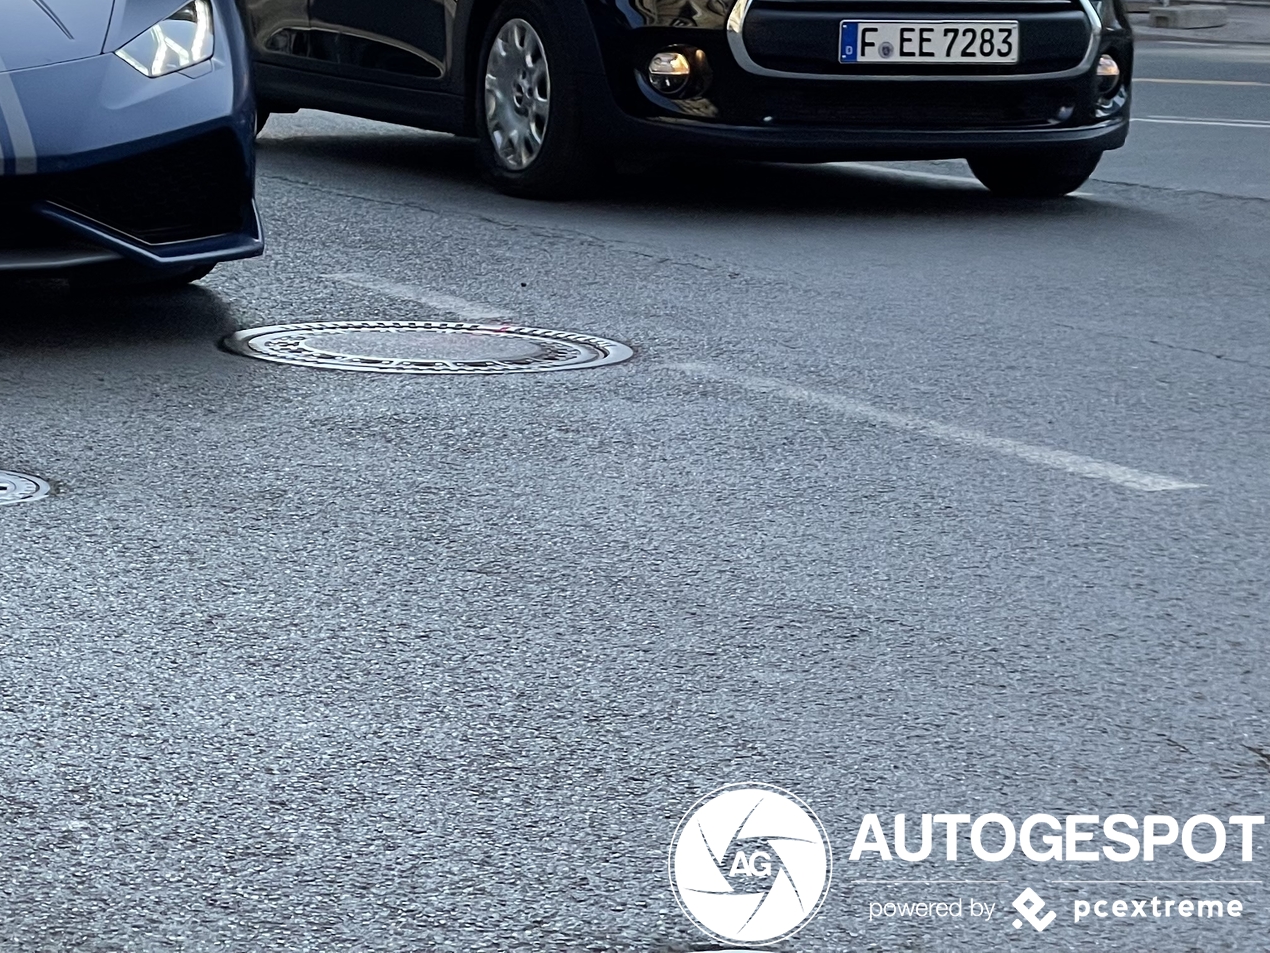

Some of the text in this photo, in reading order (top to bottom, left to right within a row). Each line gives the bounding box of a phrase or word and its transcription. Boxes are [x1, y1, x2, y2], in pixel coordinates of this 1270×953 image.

[860, 27, 879, 57] F
[899, 28, 935, 57] EE
[943, 28, 1013, 57] 7283
